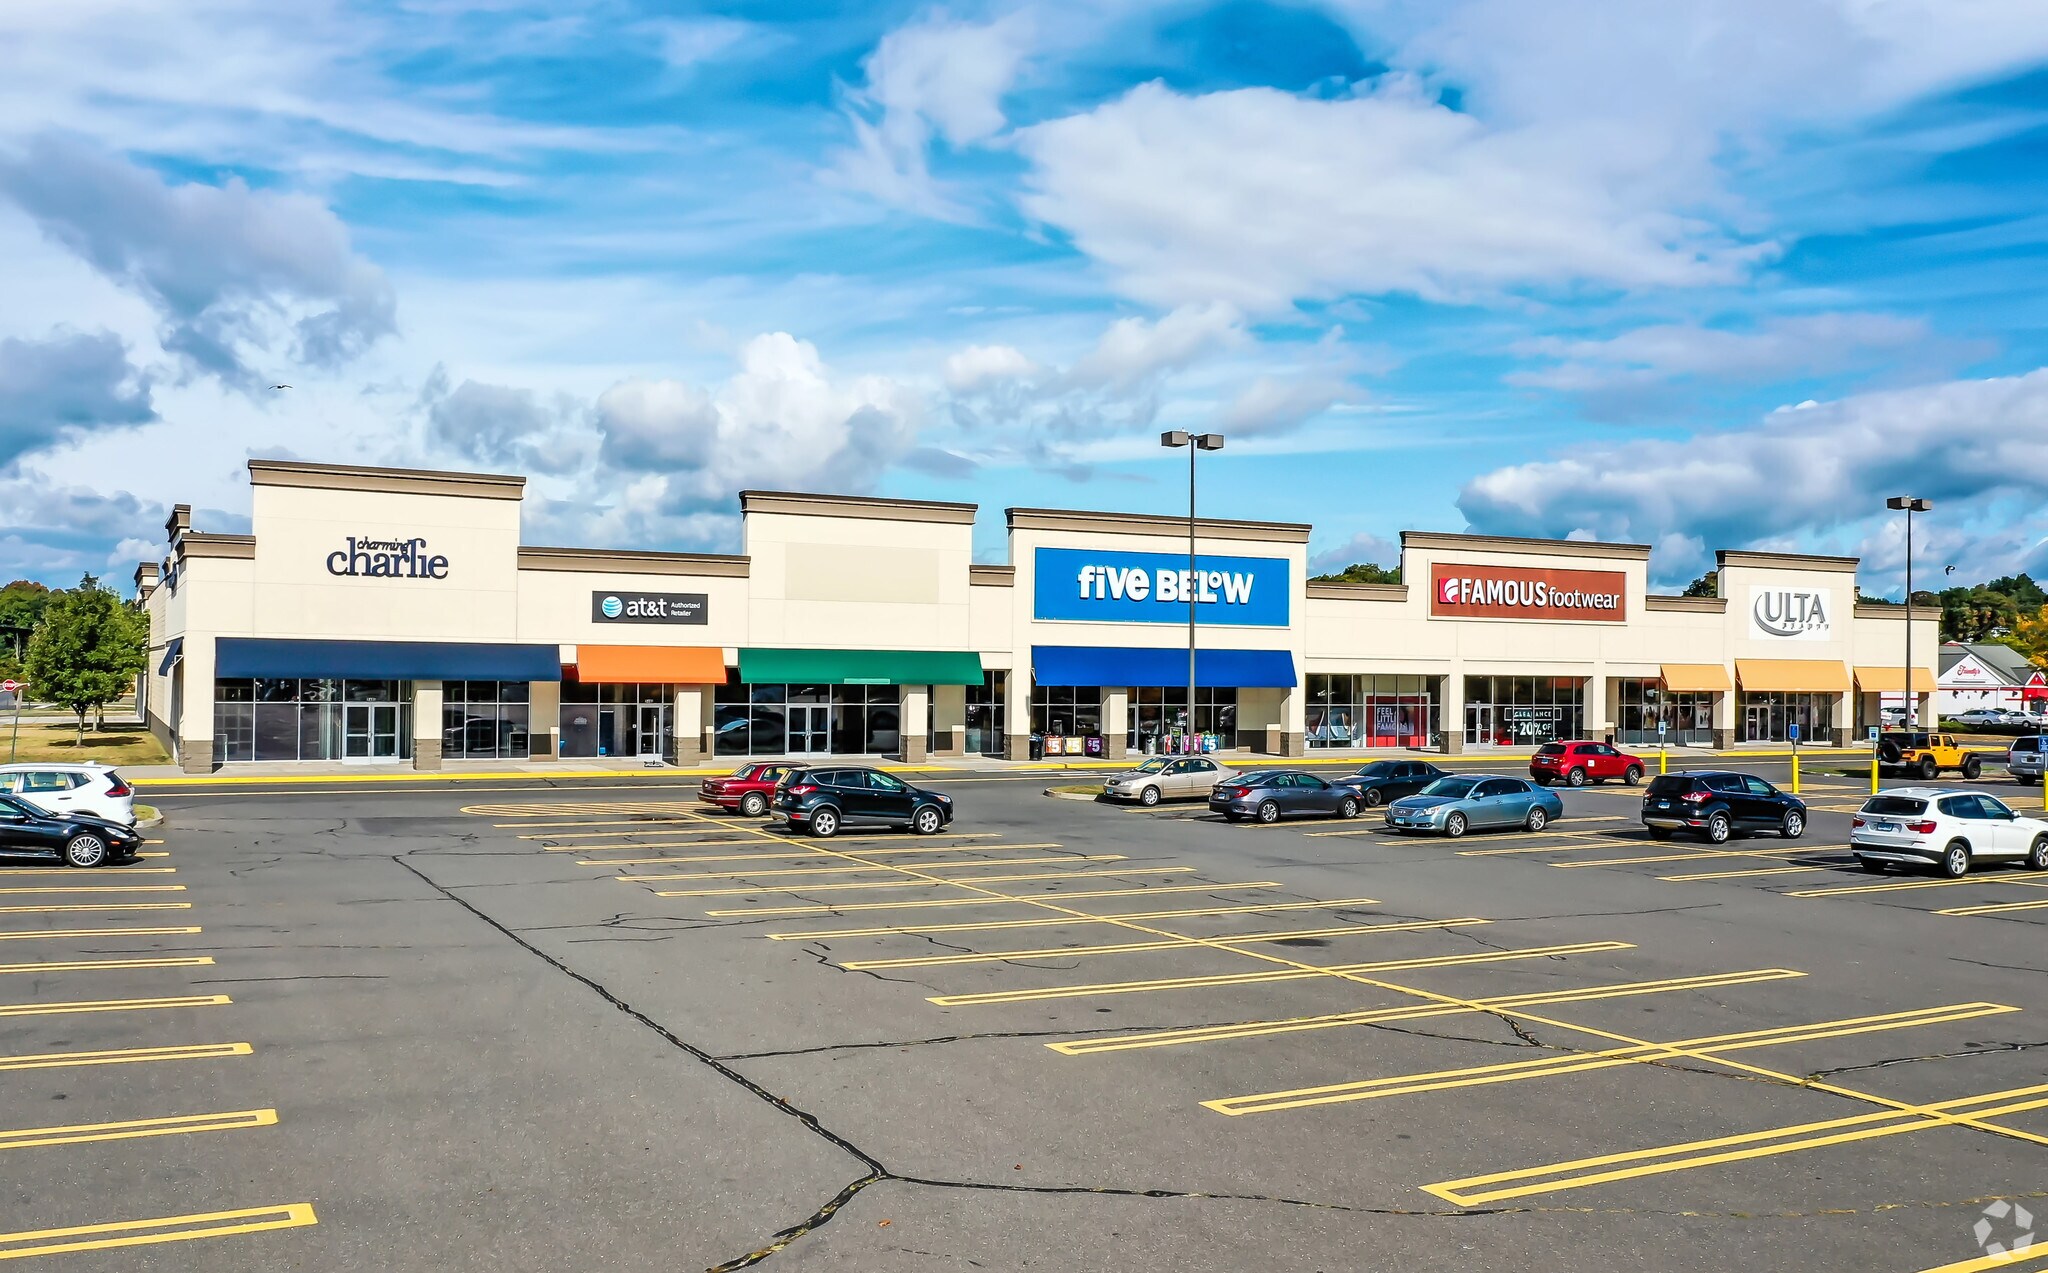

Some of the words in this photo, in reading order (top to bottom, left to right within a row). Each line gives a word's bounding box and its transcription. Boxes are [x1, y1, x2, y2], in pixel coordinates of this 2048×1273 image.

[357, 536, 409, 554] charming
[326, 537, 449, 579] charlie
[1460, 578, 1547, 607] FAMOUS
[1548, 587, 1620, 609] footwear
[626, 598, 668, 617] at&t
[1764, 592, 1826, 623] ULTA
[1376, 707, 1393, 715] FEEL
[1087, 739, 1100, 752] $5
